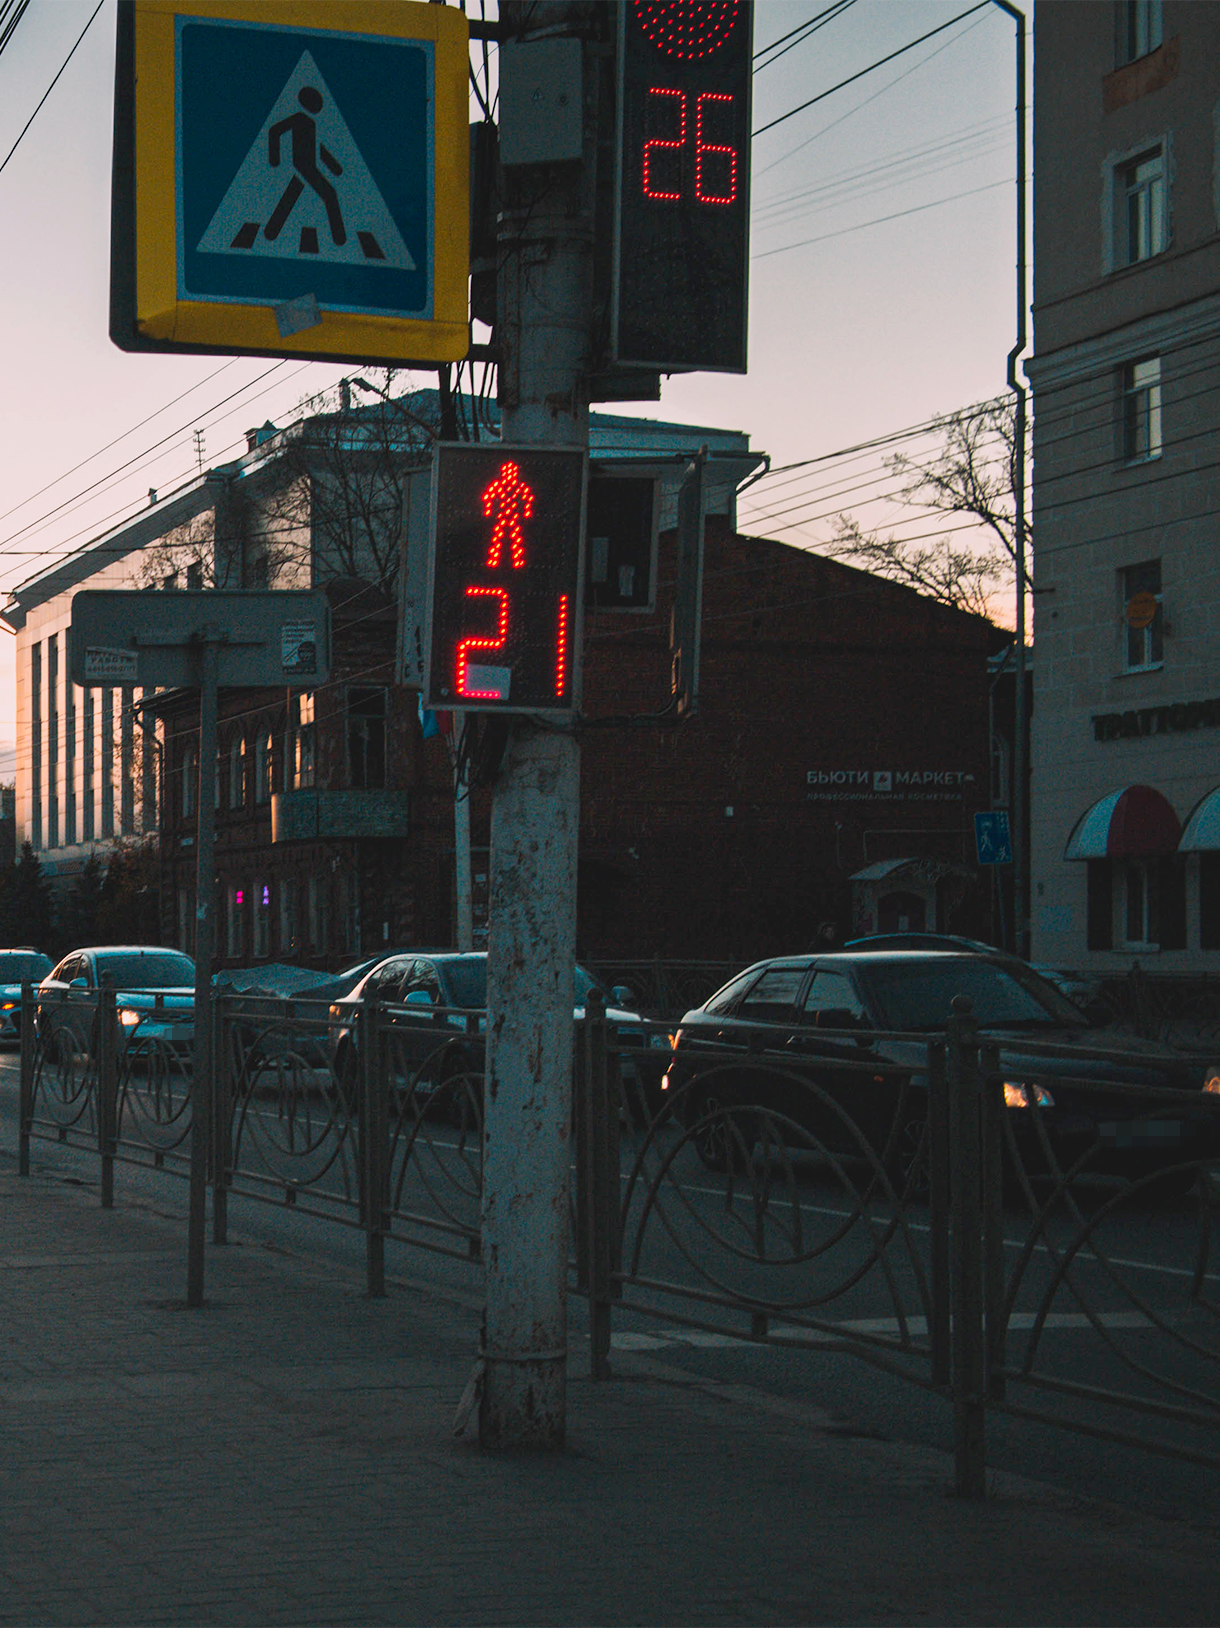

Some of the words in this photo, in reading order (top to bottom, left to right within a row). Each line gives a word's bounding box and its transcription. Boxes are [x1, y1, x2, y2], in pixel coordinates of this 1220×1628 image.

[642, 86, 738, 205] 26
[455, 585, 568, 697] 21
[806, 770, 869, 784] БЬЮТИ
[895, 770, 965, 785] МАРКЕТ
